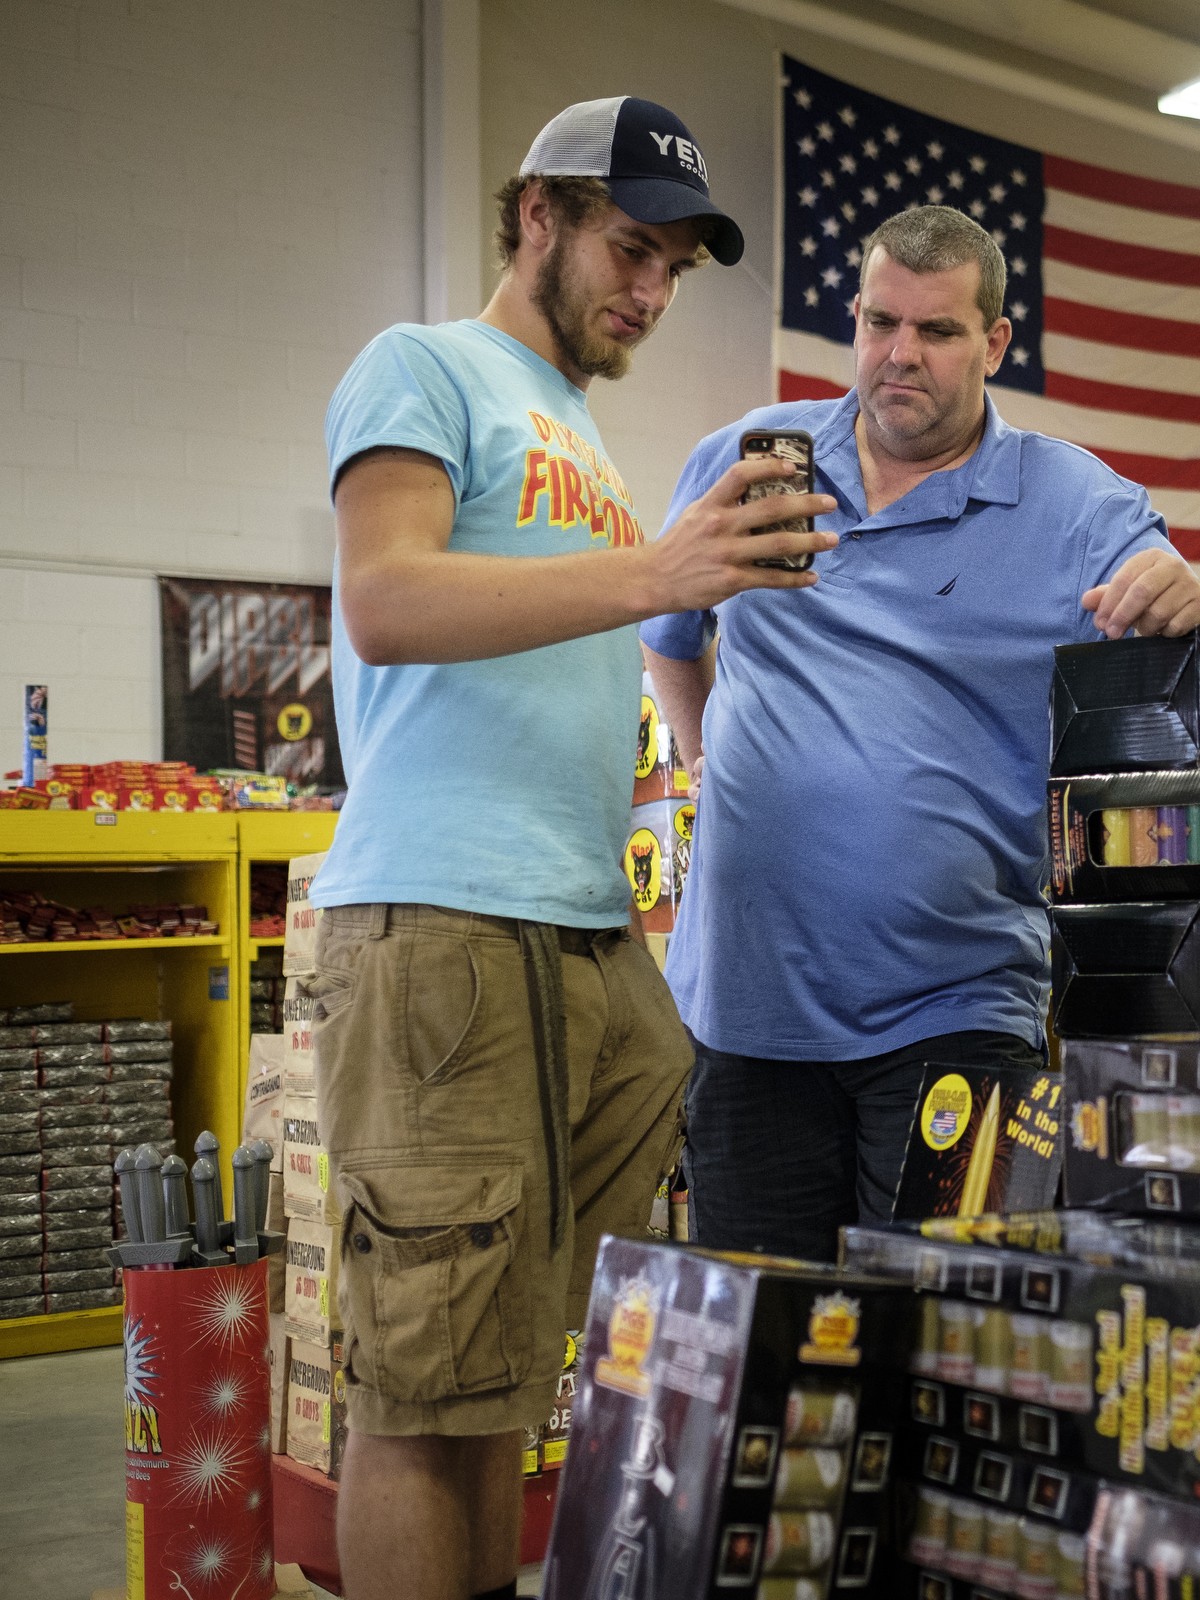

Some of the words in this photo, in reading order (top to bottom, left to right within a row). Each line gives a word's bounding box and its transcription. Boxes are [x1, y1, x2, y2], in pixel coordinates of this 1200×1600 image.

[649, 131, 708, 181] YETI
[516, 449, 648, 548] FIREOR
[188, 593, 330, 697] DIABL
[631, 842, 655, 858] Black
[635, 888, 652, 903] Cat
[1031, 1076, 1062, 1110] #1
[1016, 1099, 1032, 1121] in
[1034, 1110, 1060, 1136] the
[1006, 1118, 1055, 1159] World!
[135, 1469, 151, 1481] Bees
